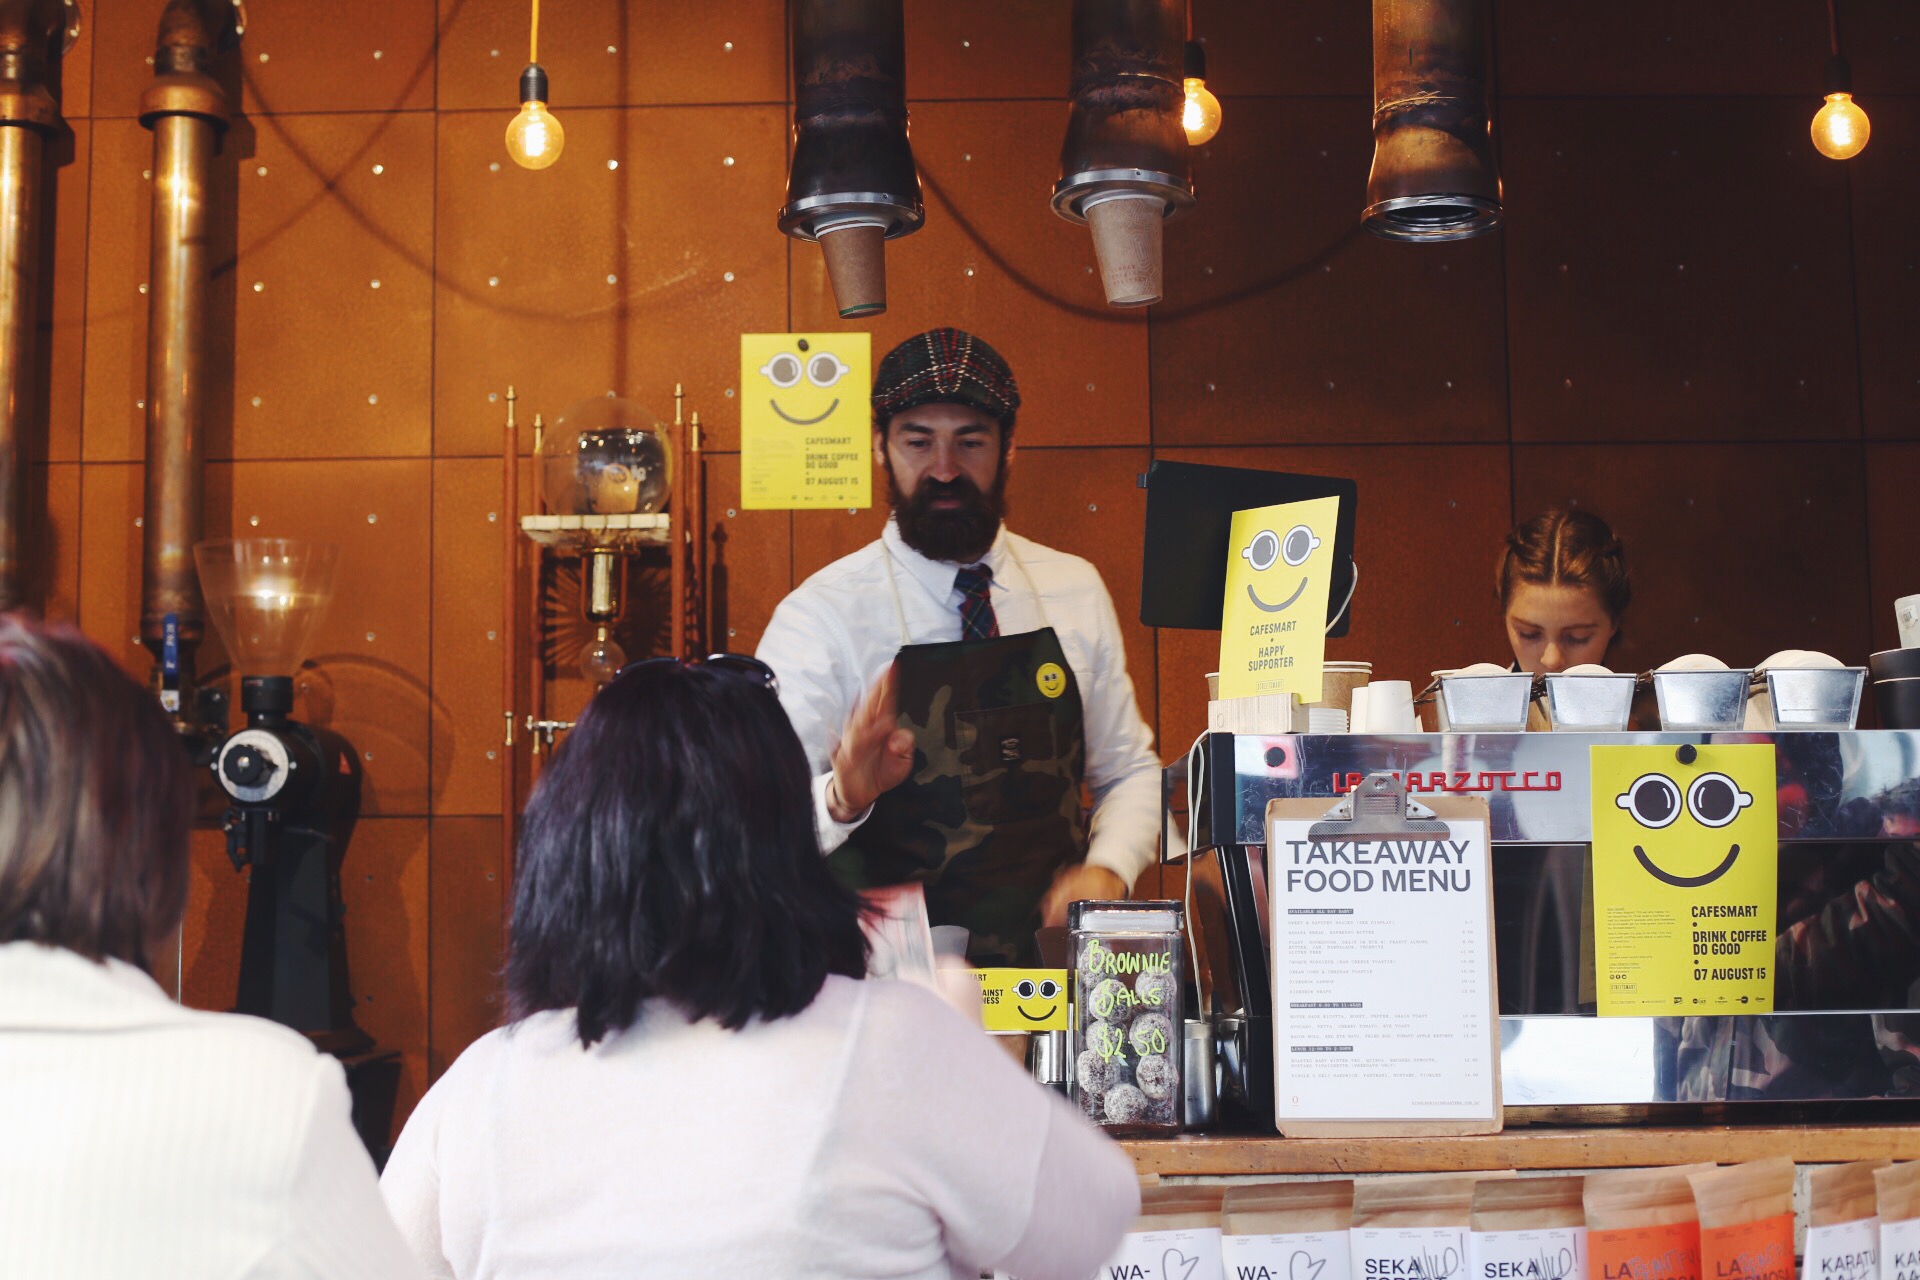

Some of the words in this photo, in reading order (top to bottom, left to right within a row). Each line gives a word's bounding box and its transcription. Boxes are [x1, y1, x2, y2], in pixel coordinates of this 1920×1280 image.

[1250, 620, 1297, 636] CAFESMART
[1258, 645, 1285, 657] HAPPY
[1248, 656, 1294, 672] SUPPORTER
[1391, 772, 1561, 793] ARZOCCO
[1286, 840, 1470, 864] TAKEAWAY
[1287, 869, 1374, 892] FOOD
[1382, 869, 1471, 892] MENU
[1691, 905, 1758, 918] CAFESMART
[1692, 931, 1727, 943] DRINK
[1730, 930, 1767, 942] COFFEE
[1087, 939, 1171, 975] BROWNIE
[1693, 943, 1708, 955] DO
[1711, 943, 1741, 955] GOOD
[1694, 968, 1708, 981] 07
[1711, 968, 1753, 980] AUGUST
[1756, 967, 1766, 980] 15
[1095, 978, 1162, 1017] BALLS
[1364, 1258, 1420, 1275] SEKA
[1717, 1259, 1741, 1277] LA
[1821, 1248, 1876, 1273] KARATU
[1895, 1250, 1920, 1269] KA
[1484, 1261, 1539, 1278] SEKA
[1604, 1262, 1632, 1280] LA
